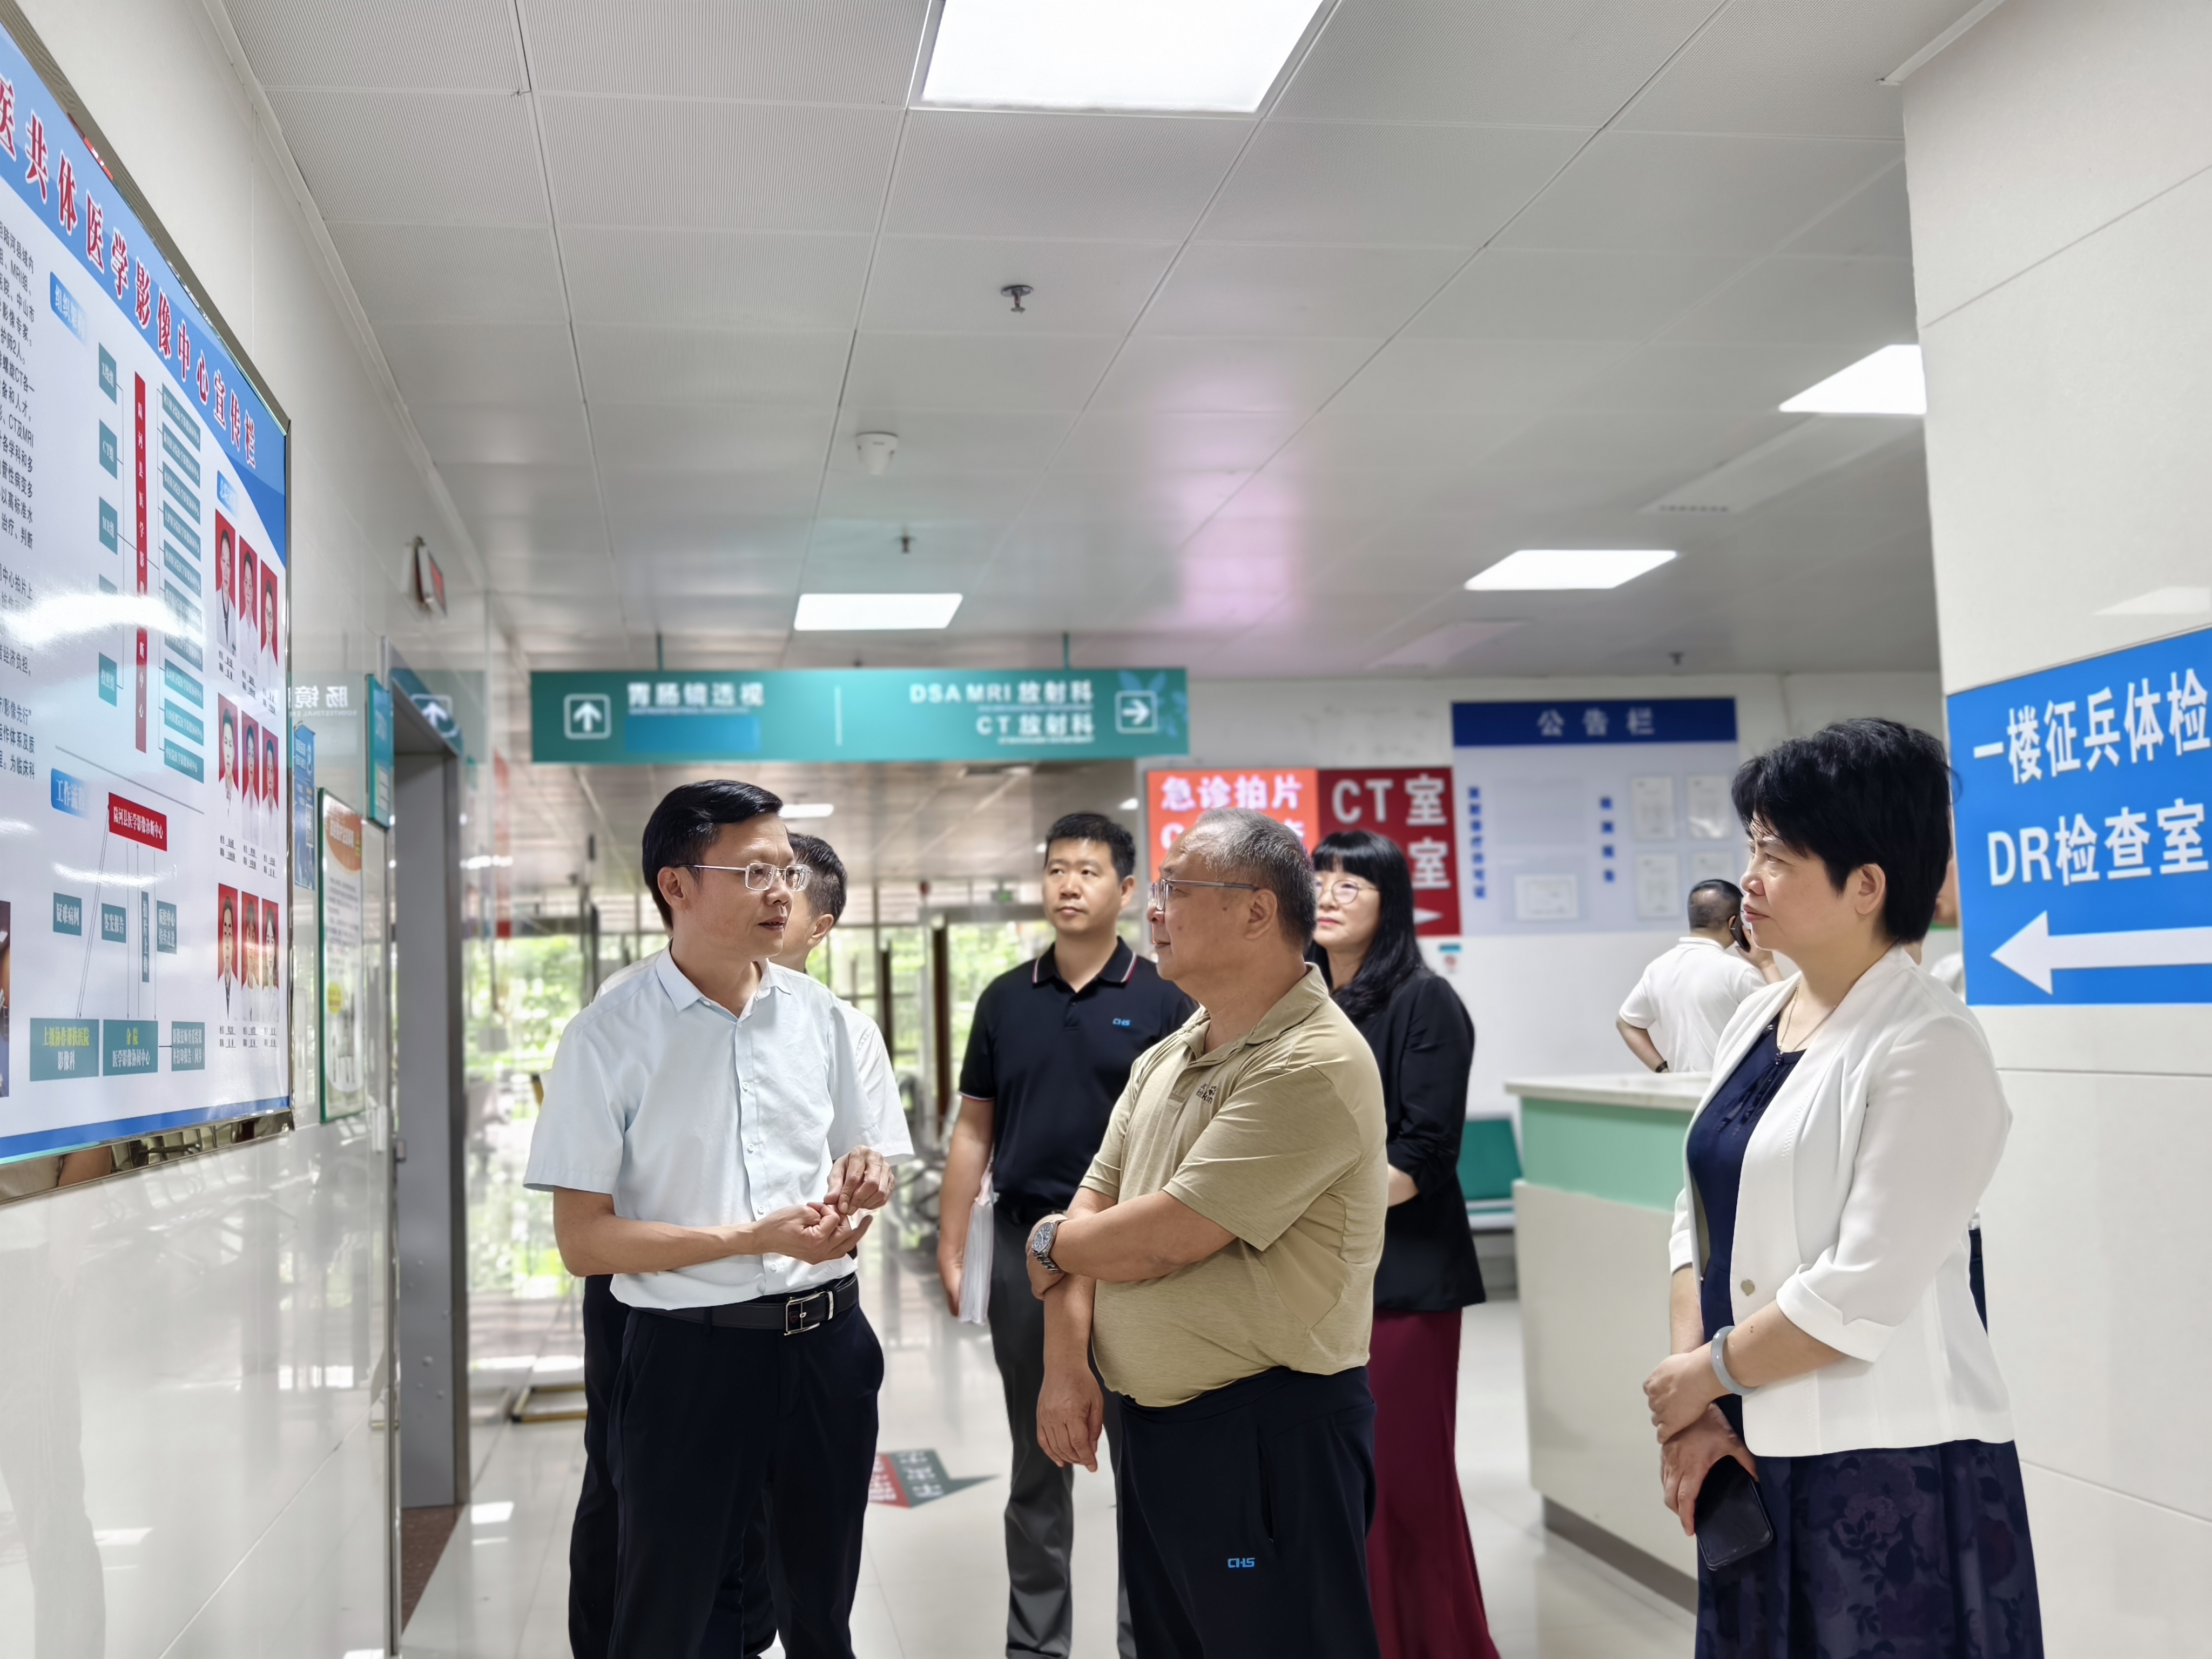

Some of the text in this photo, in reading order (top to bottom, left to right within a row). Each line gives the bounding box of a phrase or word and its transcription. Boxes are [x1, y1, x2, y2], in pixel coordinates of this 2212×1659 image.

[1537, 707, 1655, 737] 公告栏
[1973, 668, 2211, 784] 一楼征兵体检
[1162, 774, 1302, 811] 急诊拍片
[1988, 799, 2209, 886] DR检查室
